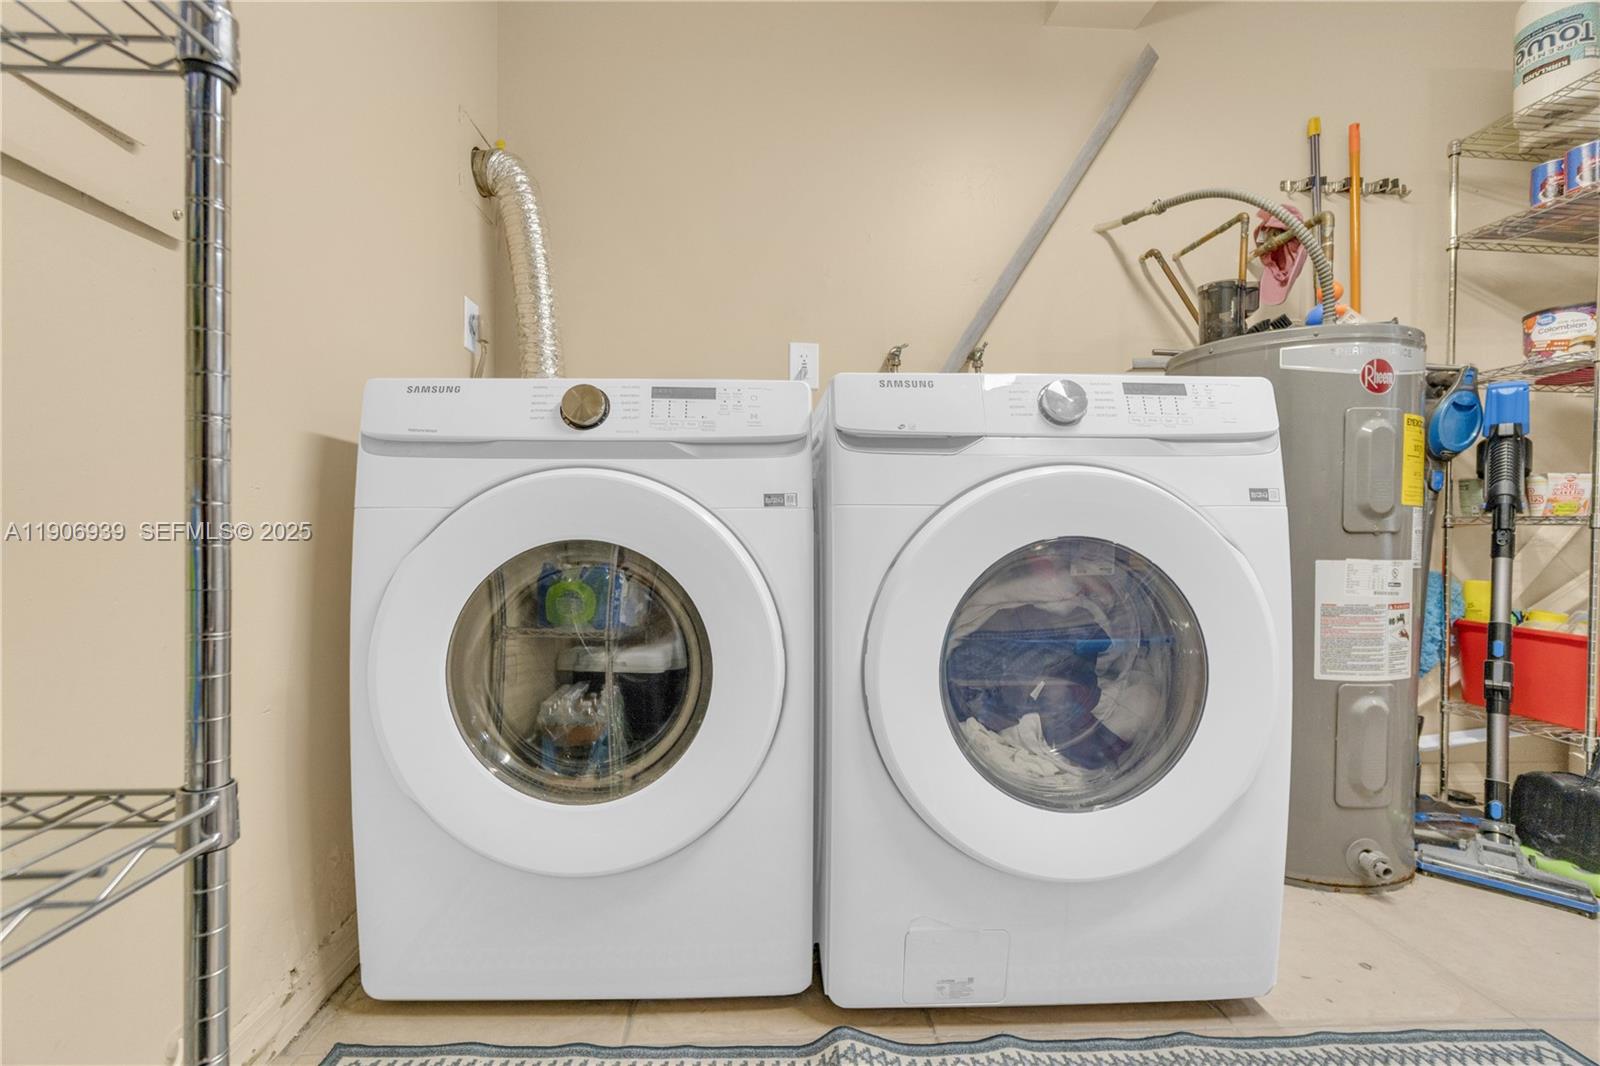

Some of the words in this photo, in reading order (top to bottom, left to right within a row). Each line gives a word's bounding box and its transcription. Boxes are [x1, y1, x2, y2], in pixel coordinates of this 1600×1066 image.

[1364, 359, 1394, 390] Rheem
[879, 379, 934, 389] SAMSUNG
[406, 385, 461, 394] SAMSUNG
